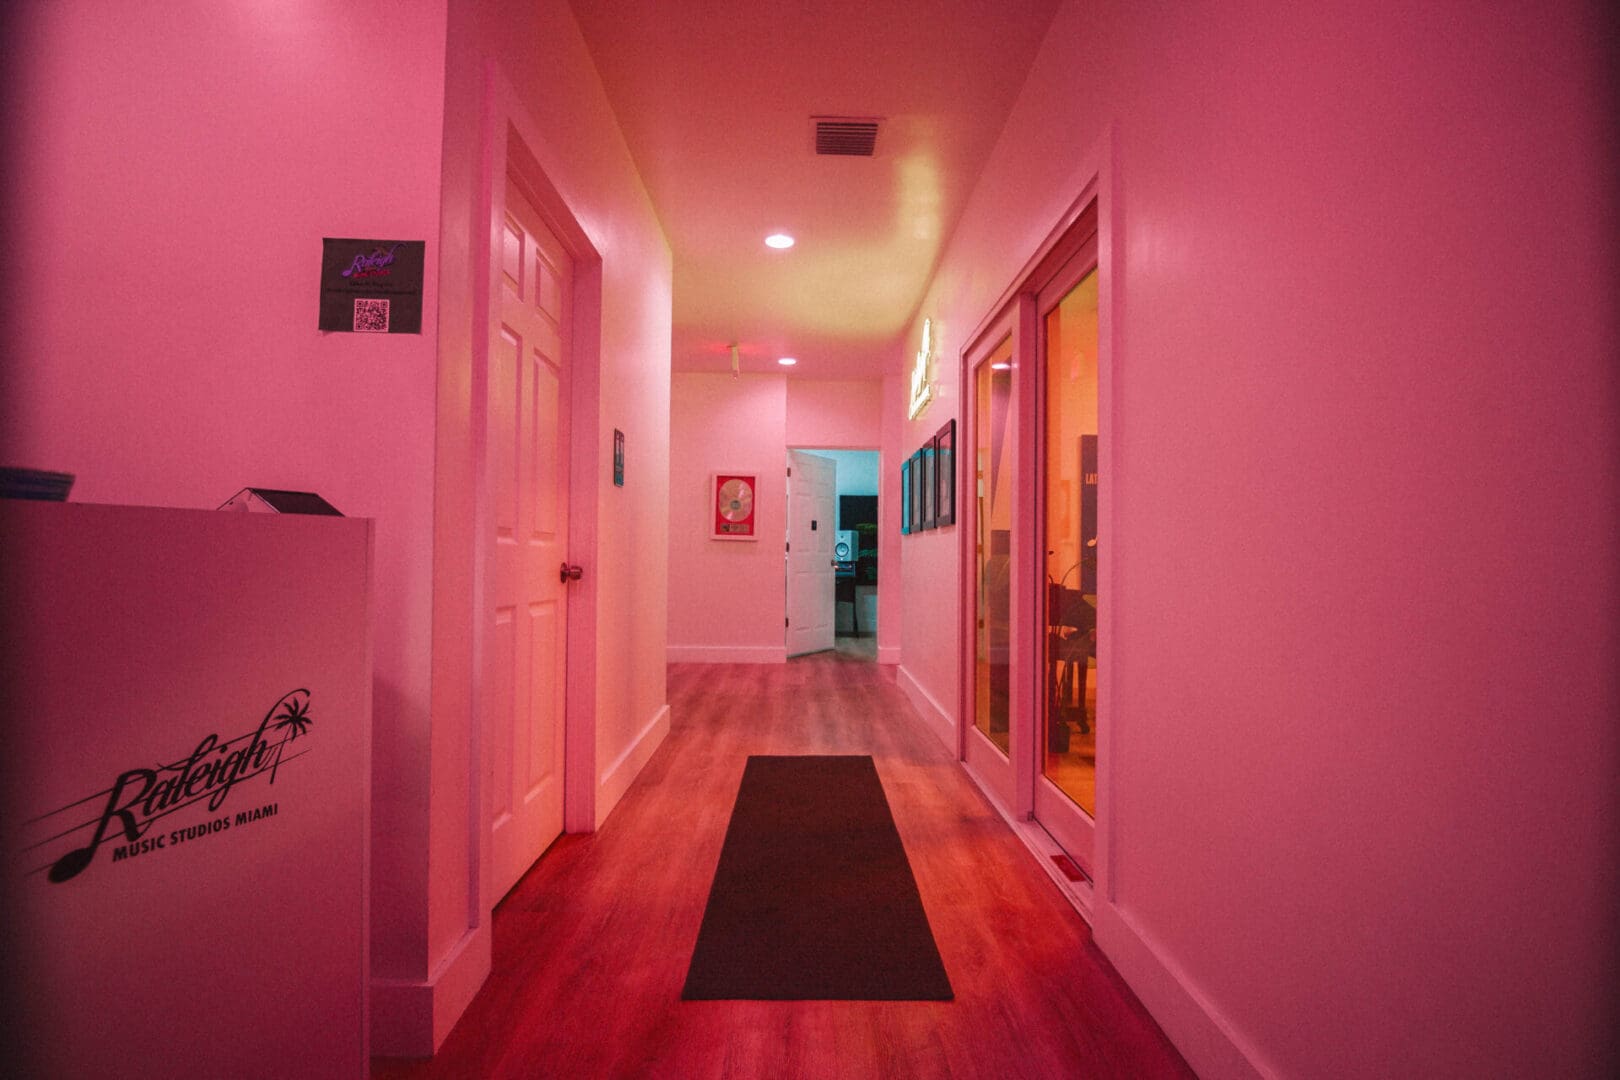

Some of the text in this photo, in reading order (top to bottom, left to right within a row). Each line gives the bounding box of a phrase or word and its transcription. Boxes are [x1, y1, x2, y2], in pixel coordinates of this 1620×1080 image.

[48, 688, 311, 884] Raleigh
[112, 803, 279, 863] MUSIC STUDIOS MIAMI
